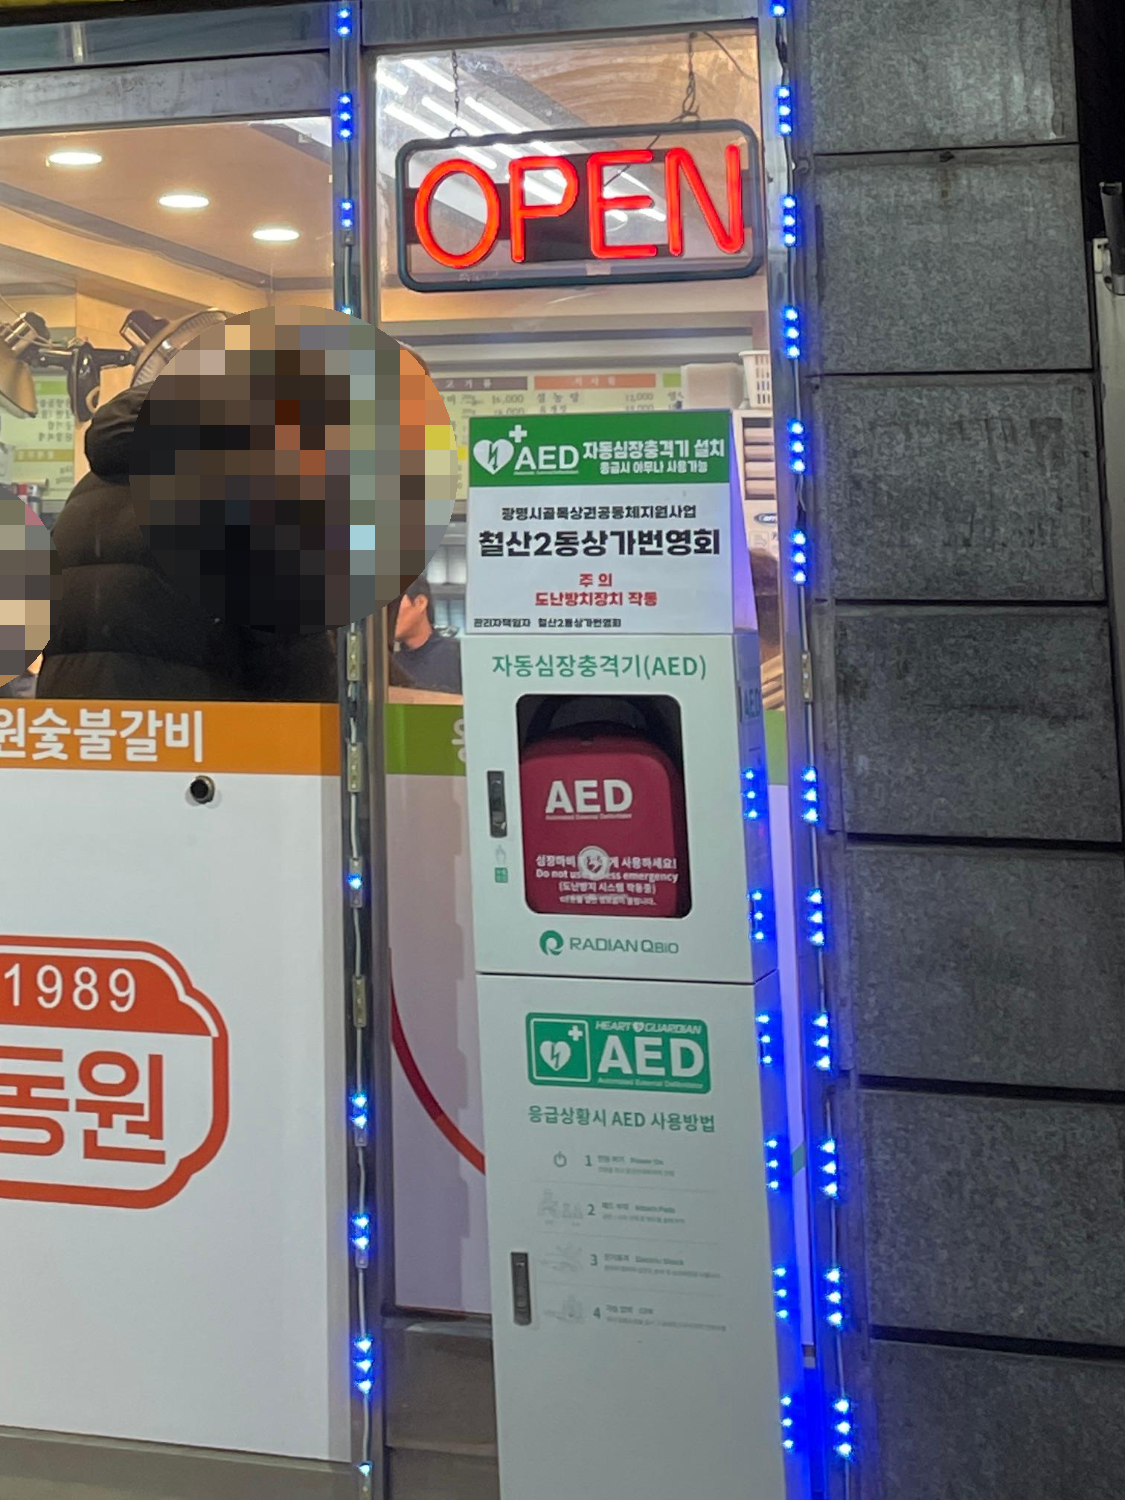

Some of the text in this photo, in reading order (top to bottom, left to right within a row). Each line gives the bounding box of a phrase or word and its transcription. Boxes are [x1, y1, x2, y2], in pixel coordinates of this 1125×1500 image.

[414, 144, 745, 269] OPEN
[513, 444, 580, 471] AED
[582, 438, 725, 461] 자동심장충격기 설치
[632, 460, 664, 475] 아무나
[666, 459, 709, 474] 사용가능
[478, 528, 722, 558] 철산2동상가번영회
[628, 591, 658, 607] 작동
[491, 654, 707, 681] 자동심장충격기(AED)
[544, 778, 634, 814] AED
[535, 868, 550, 878] Do
[551, 869, 568, 879] not
[622, 872, 679, 884] emergency
[569, 937, 639, 953] RADIAN
[3, 962, 138, 1013] 1989
[595, 1020, 702, 1035] HEART GUARDIAN
[597, 1035, 706, 1078] AED
[528, 1105, 716, 1133] 응급상황시 AED 사용방법
